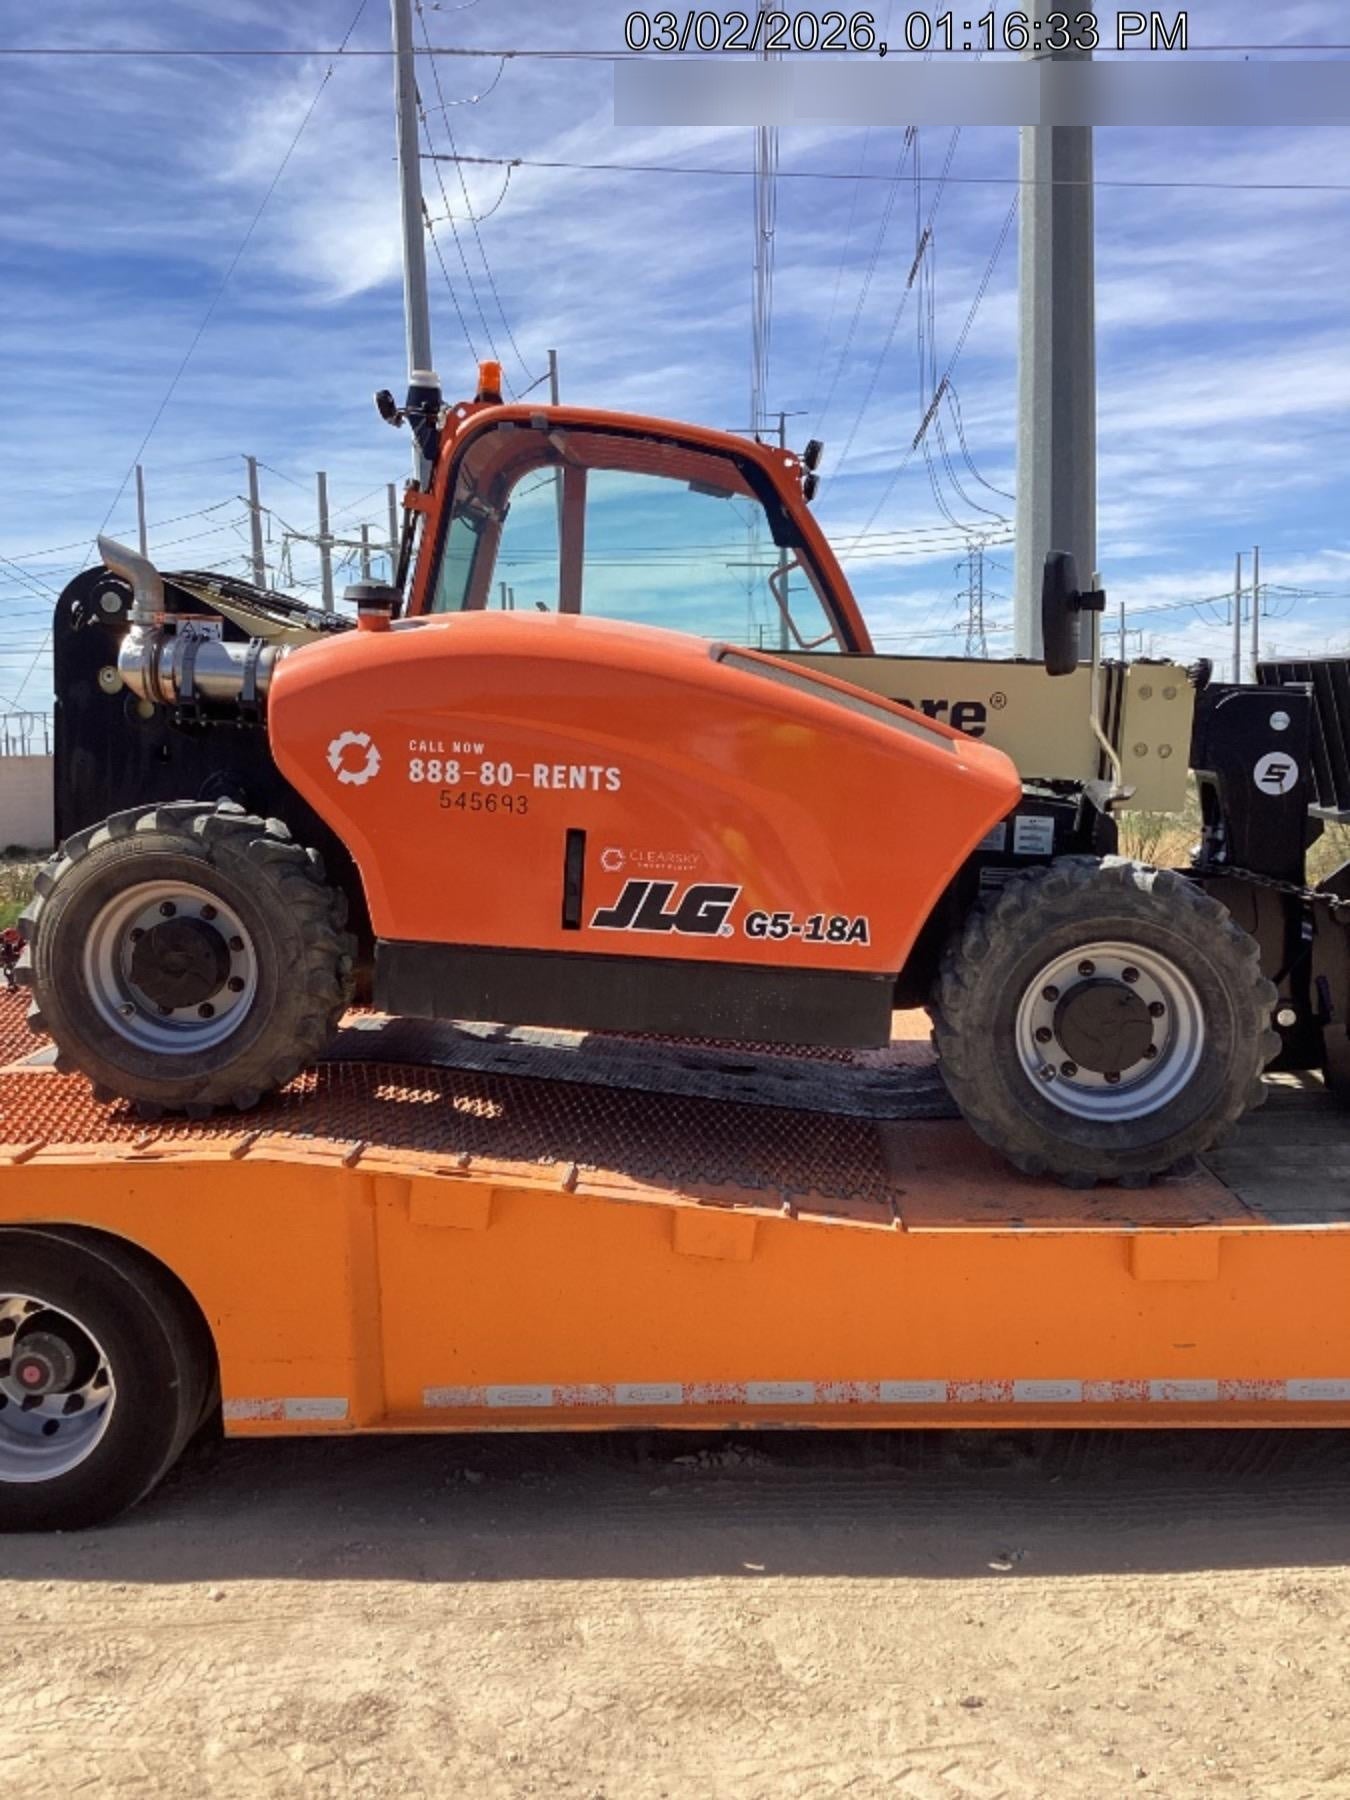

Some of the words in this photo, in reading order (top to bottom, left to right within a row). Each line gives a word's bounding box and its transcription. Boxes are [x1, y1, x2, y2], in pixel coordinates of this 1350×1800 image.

[409, 739, 445, 753] CALL
[453, 741, 485, 754] NOW
[408, 758, 622, 791] 888-80-RENTS
[439, 790, 530, 815] 545693
[629, 849, 700, 864] CLEARSKY
[744, 911, 871, 946] G5-18A
